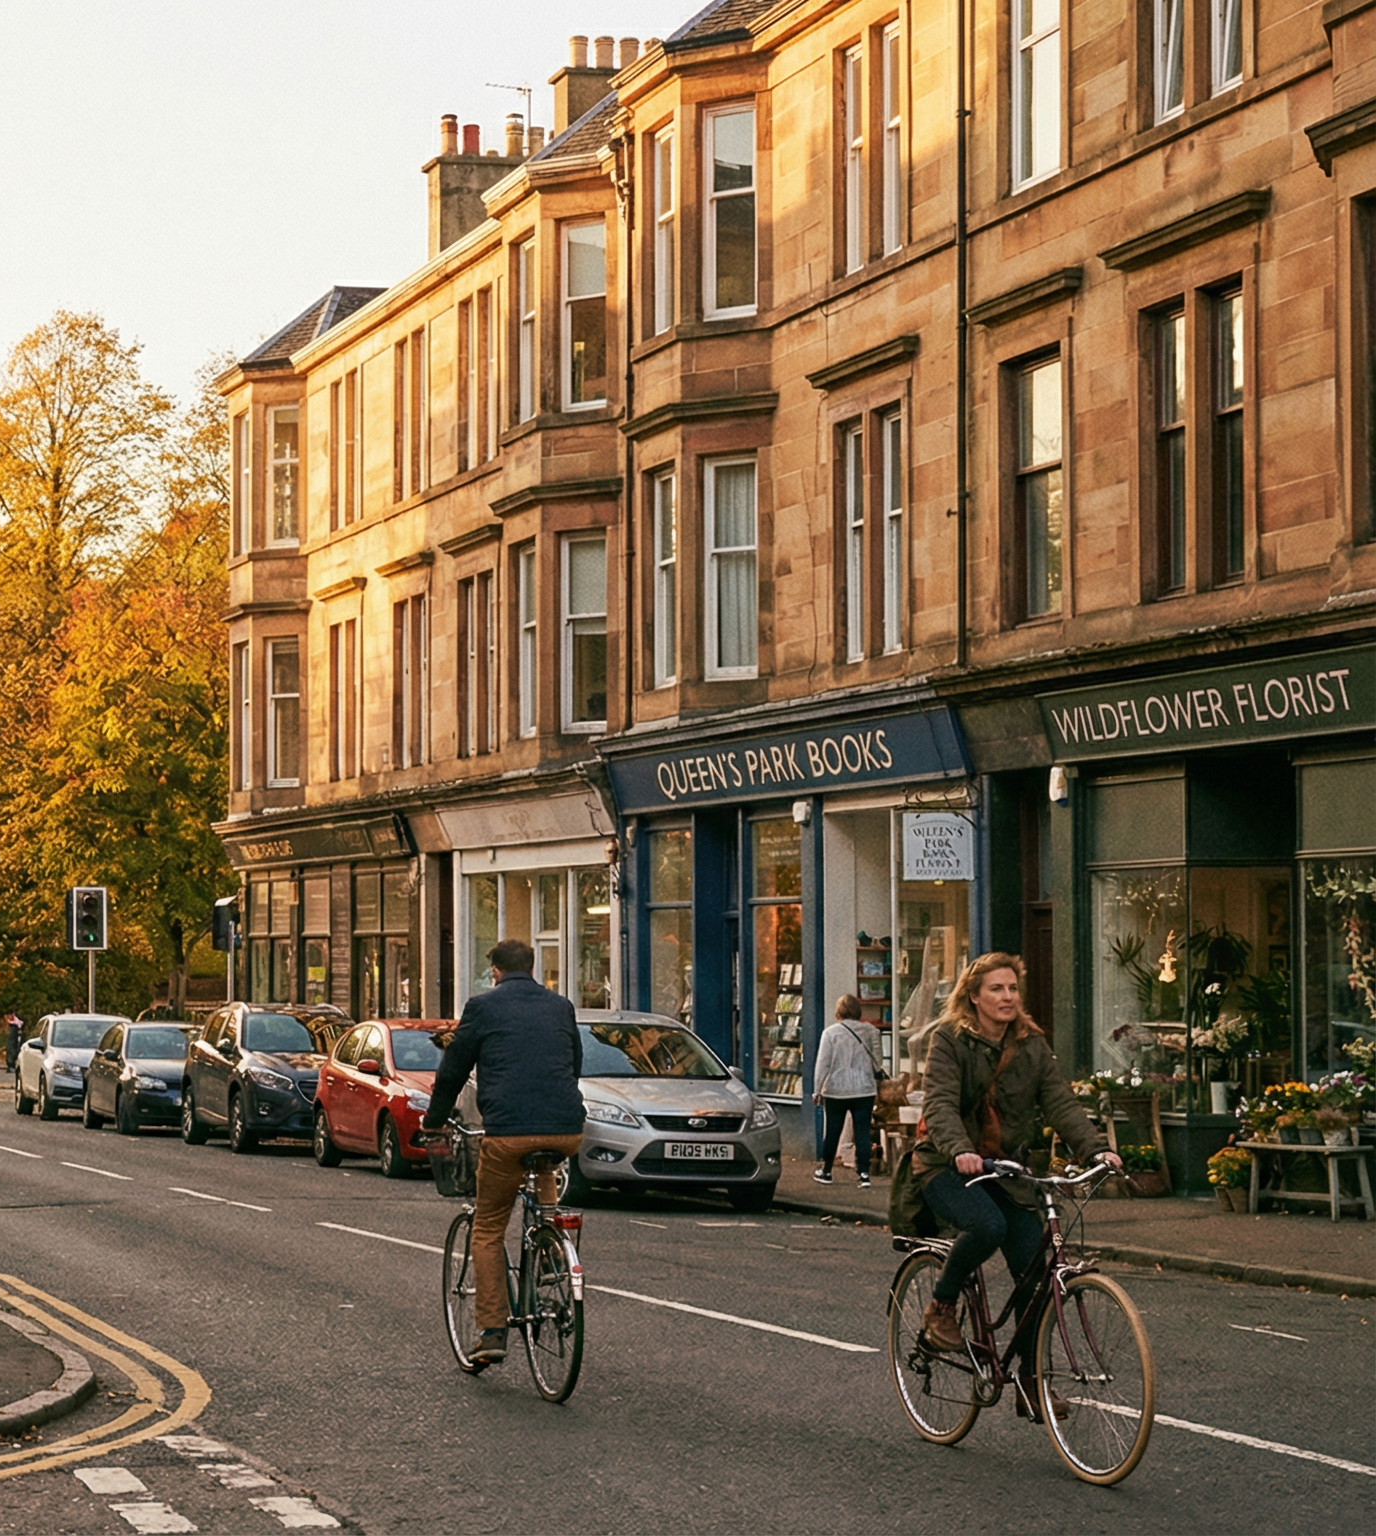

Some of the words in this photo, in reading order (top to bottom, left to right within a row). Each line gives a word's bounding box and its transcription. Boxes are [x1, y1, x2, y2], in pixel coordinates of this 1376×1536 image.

[1051, 688, 1230, 744] WILDFLOWER
[1232, 668, 1350, 724] FLORIST
[657, 752, 743, 801] QUEEN'S
[745, 743, 805, 786] PARK
[806, 729, 893, 778] BOOKS
